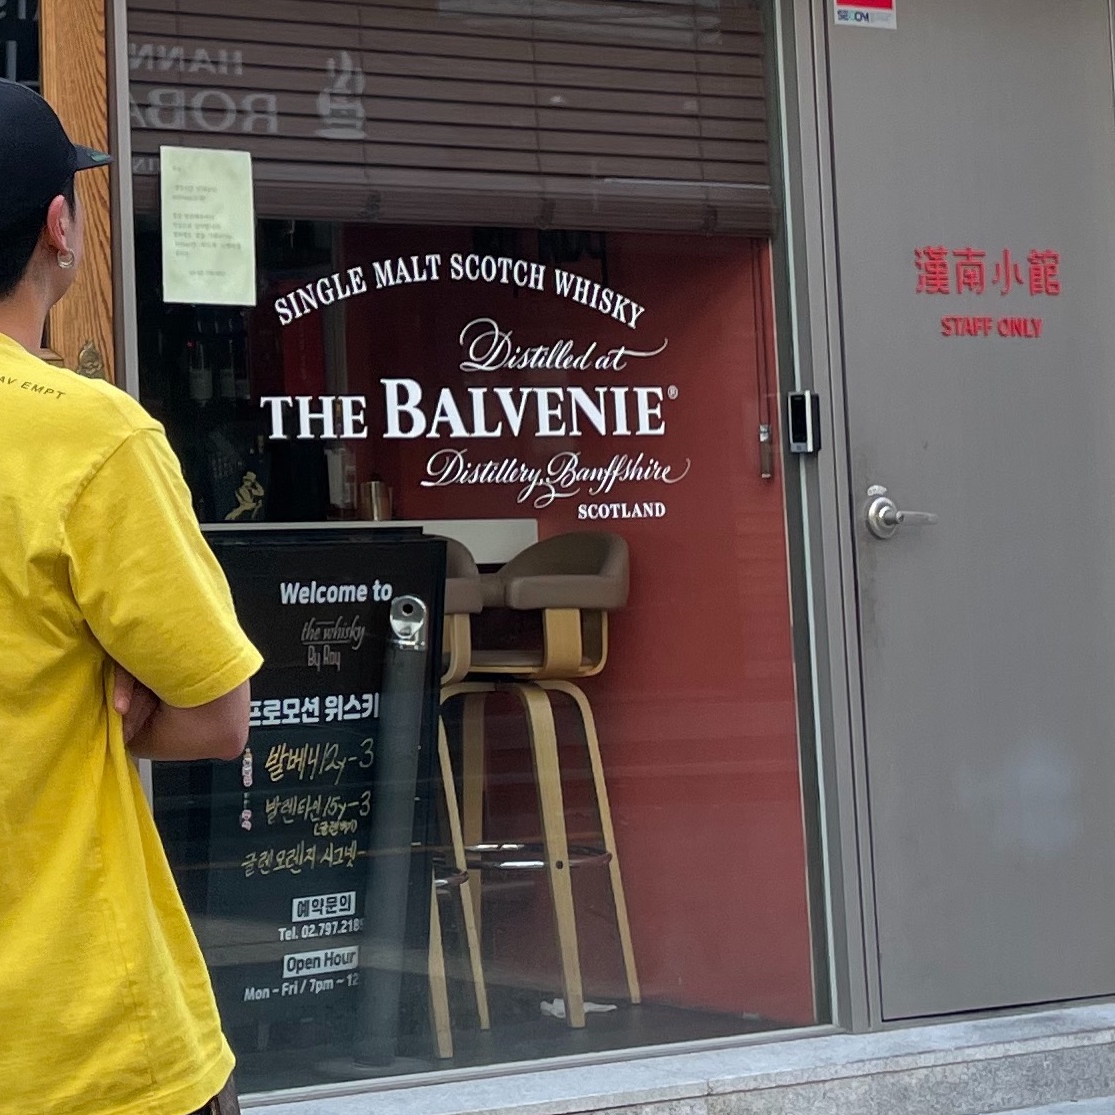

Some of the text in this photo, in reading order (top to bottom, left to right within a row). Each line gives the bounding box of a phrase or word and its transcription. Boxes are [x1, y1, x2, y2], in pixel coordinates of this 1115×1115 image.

[274, 253, 645, 329] SINGLE MALT SCOTCH WHISKY
[940, 316, 1043, 338] STAFF ONLY
[459, 317, 669, 371] Distilled at
[20, 381, 66, 399] EMPT
[260, 395, 368, 439] THE
[534, 451, 691, 509] Banffshire
[578, 502, 667, 520] SCOTLAND
[280, 579, 393, 605] Welcome to
[301, 615, 365, 650] the whisky
[308, 645, 320, 672] By
[249, 692, 379, 726] 프로모션 위스키
[297, 894, 352, 918] 예약문의
[278, 926, 299, 941] Tel.
[287, 951, 357, 974] Open Hour
[244, 987, 270, 1001] Mon
[281, 980, 298, 996] Fri
[309, 978, 334, 994] 7pm
